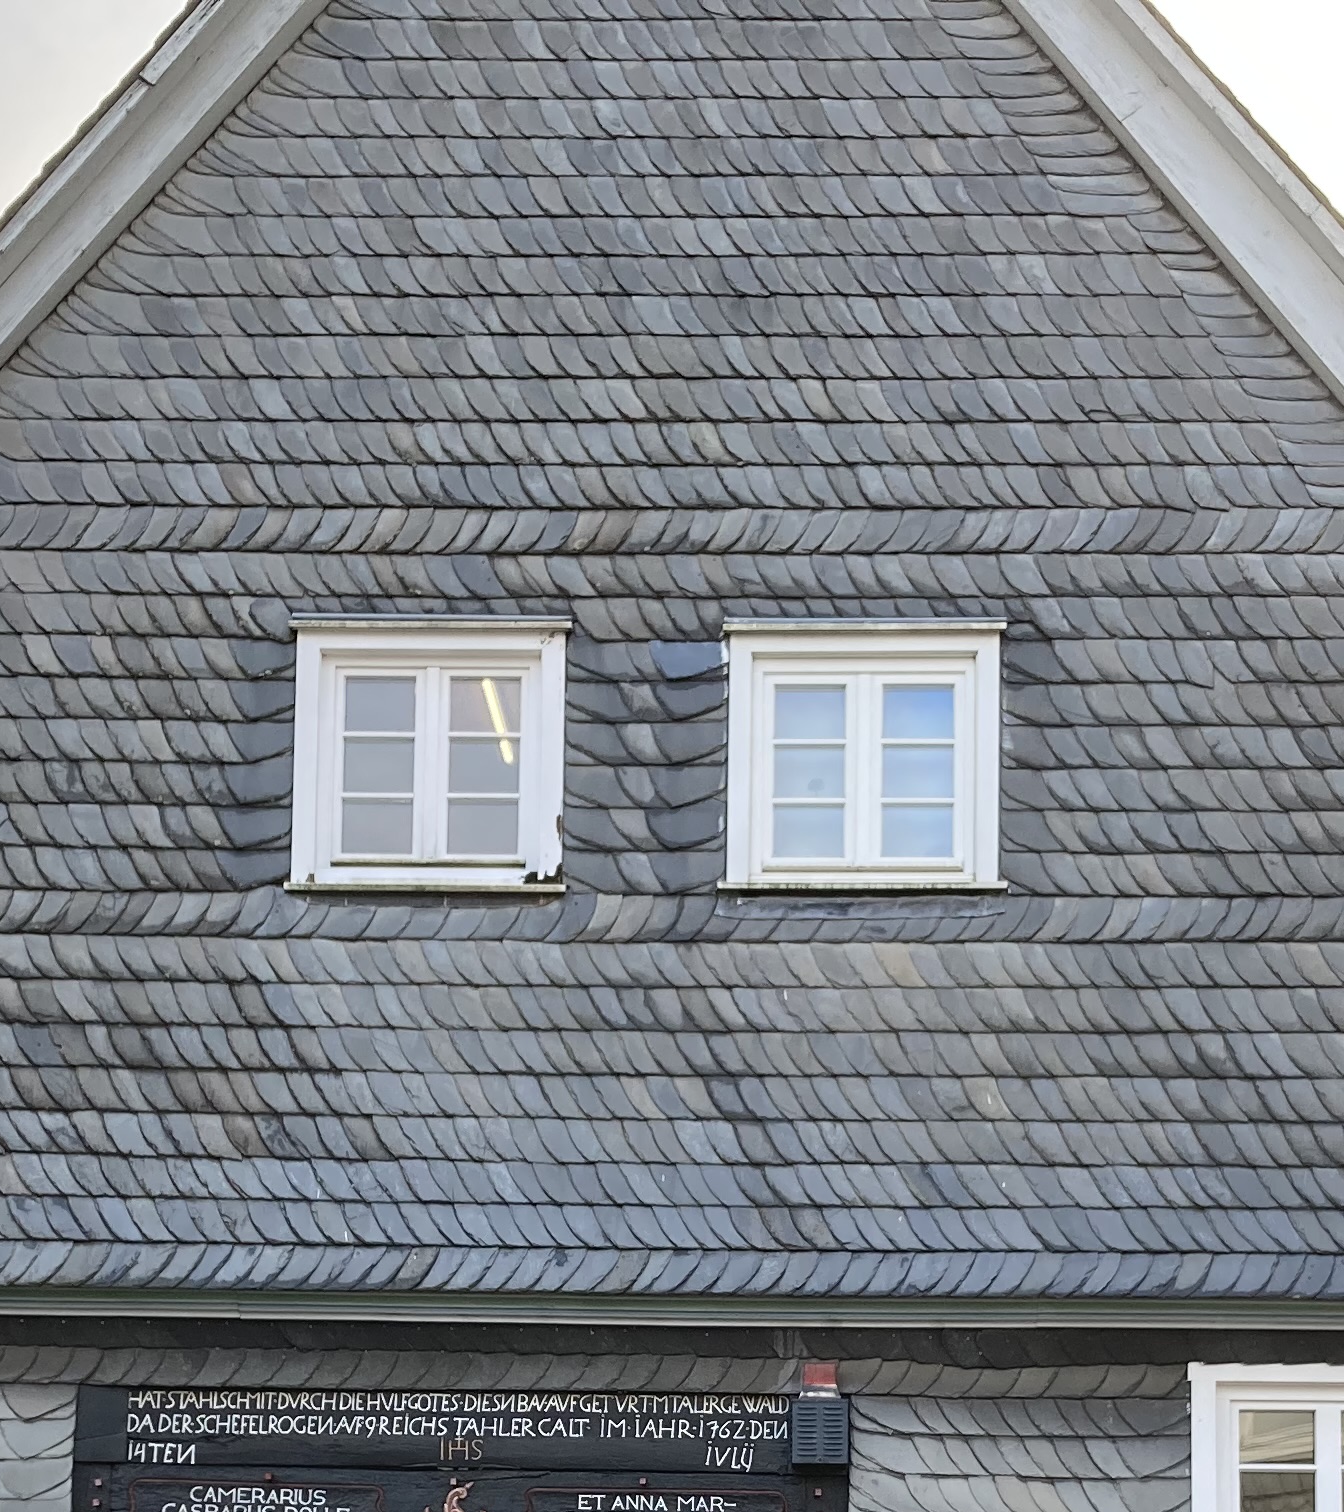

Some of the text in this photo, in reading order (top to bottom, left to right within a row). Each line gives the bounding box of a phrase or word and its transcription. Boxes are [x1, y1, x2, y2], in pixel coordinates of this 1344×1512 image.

[189, 1486, 327, 1505] CAMERARIUS
[577, 1494, 737, 1512] ET ANNA MAR-
